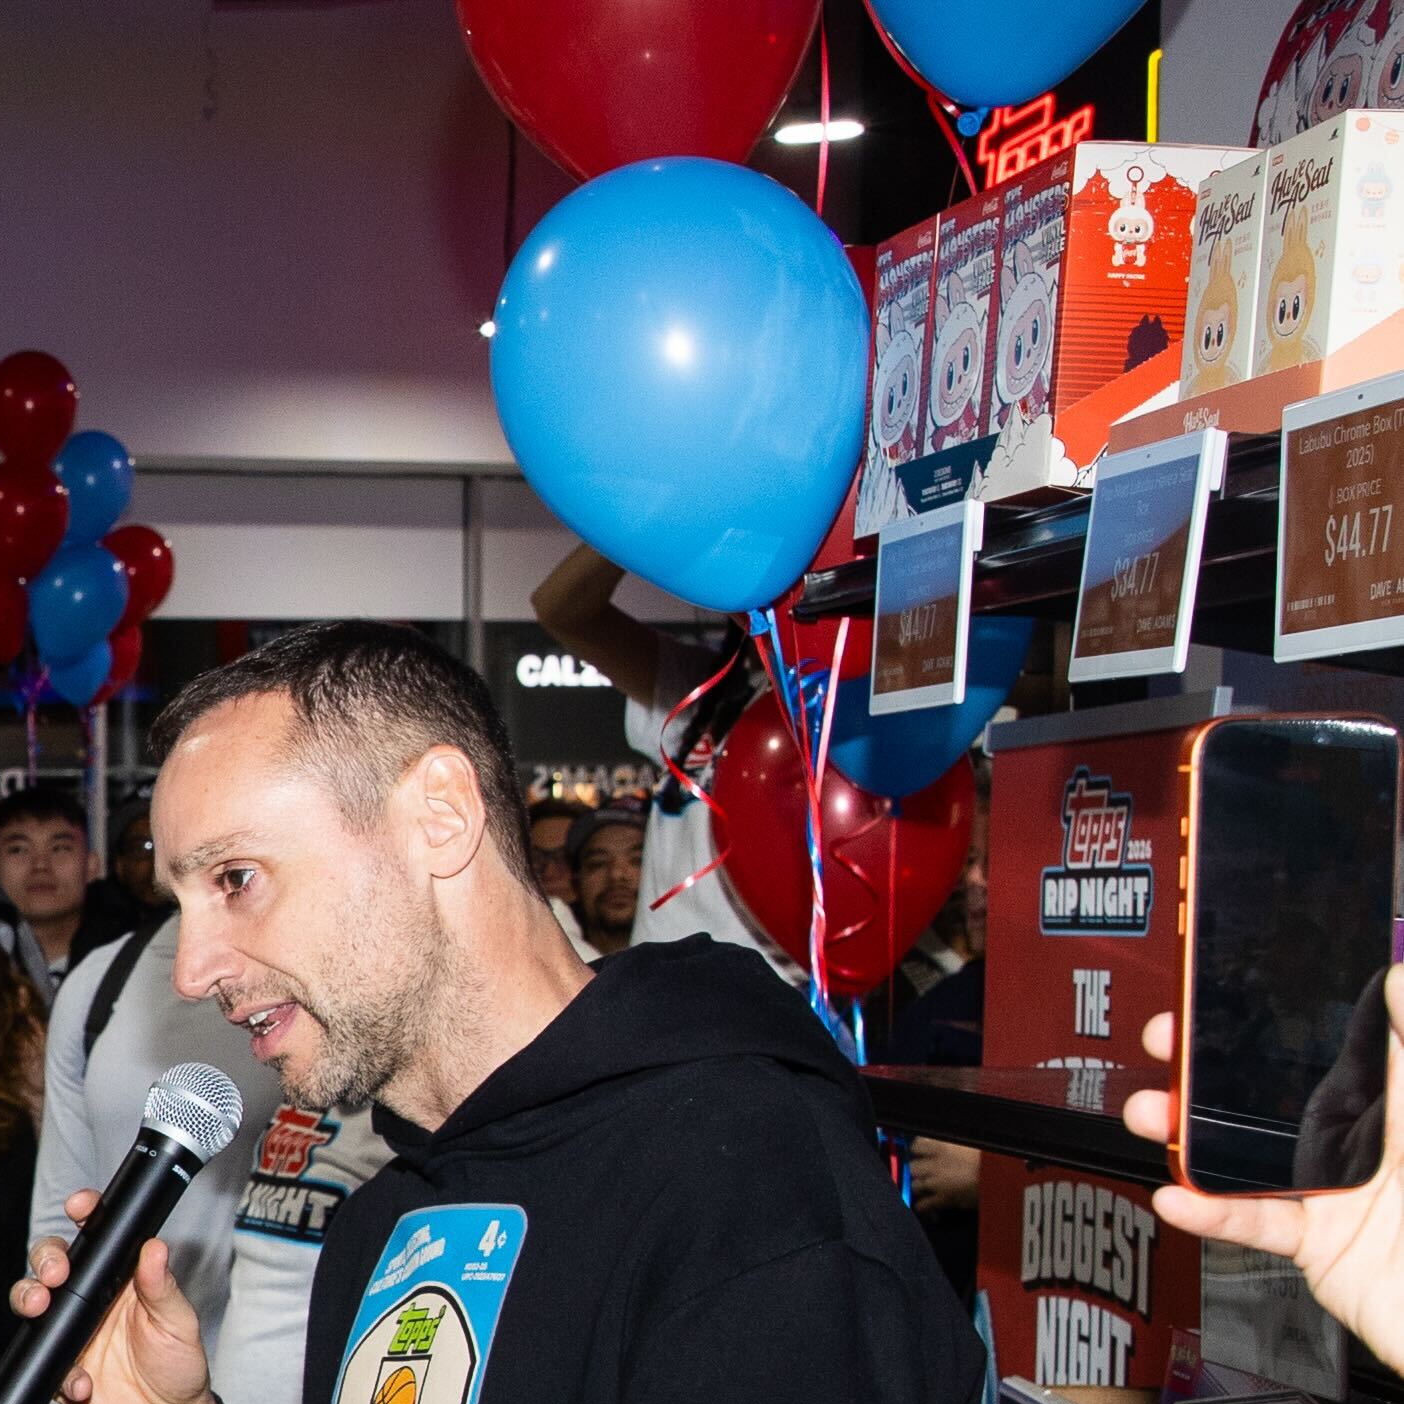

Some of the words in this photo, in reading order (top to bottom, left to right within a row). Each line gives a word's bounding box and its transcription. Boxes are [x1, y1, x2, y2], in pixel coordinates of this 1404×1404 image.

[1299, 430, 1332, 455] Labubu
[1334, 420, 1371, 446] Chrome
[1372, 414, 1393, 436] Box
[1346, 443, 1374, 469] 2025)
[1335, 484, 1355, 504] BOX
[1356, 478, 1383, 502] PRICE
[1324, 504, 1393, 567] $44.77
[1110, 552, 1160, 601] $34.77
[1370, 582, 1392, 601] DAVE
[1127, 839, 1152, 860] 2026
[1044, 878, 1078, 916] RIP
[1080, 876, 1149, 917] NIGHT
[1072, 969, 1111, 1038] THE
[1021, 1181, 1157, 1317] BIGGEST
[1035, 1296, 1134, 1387] NIGHT
